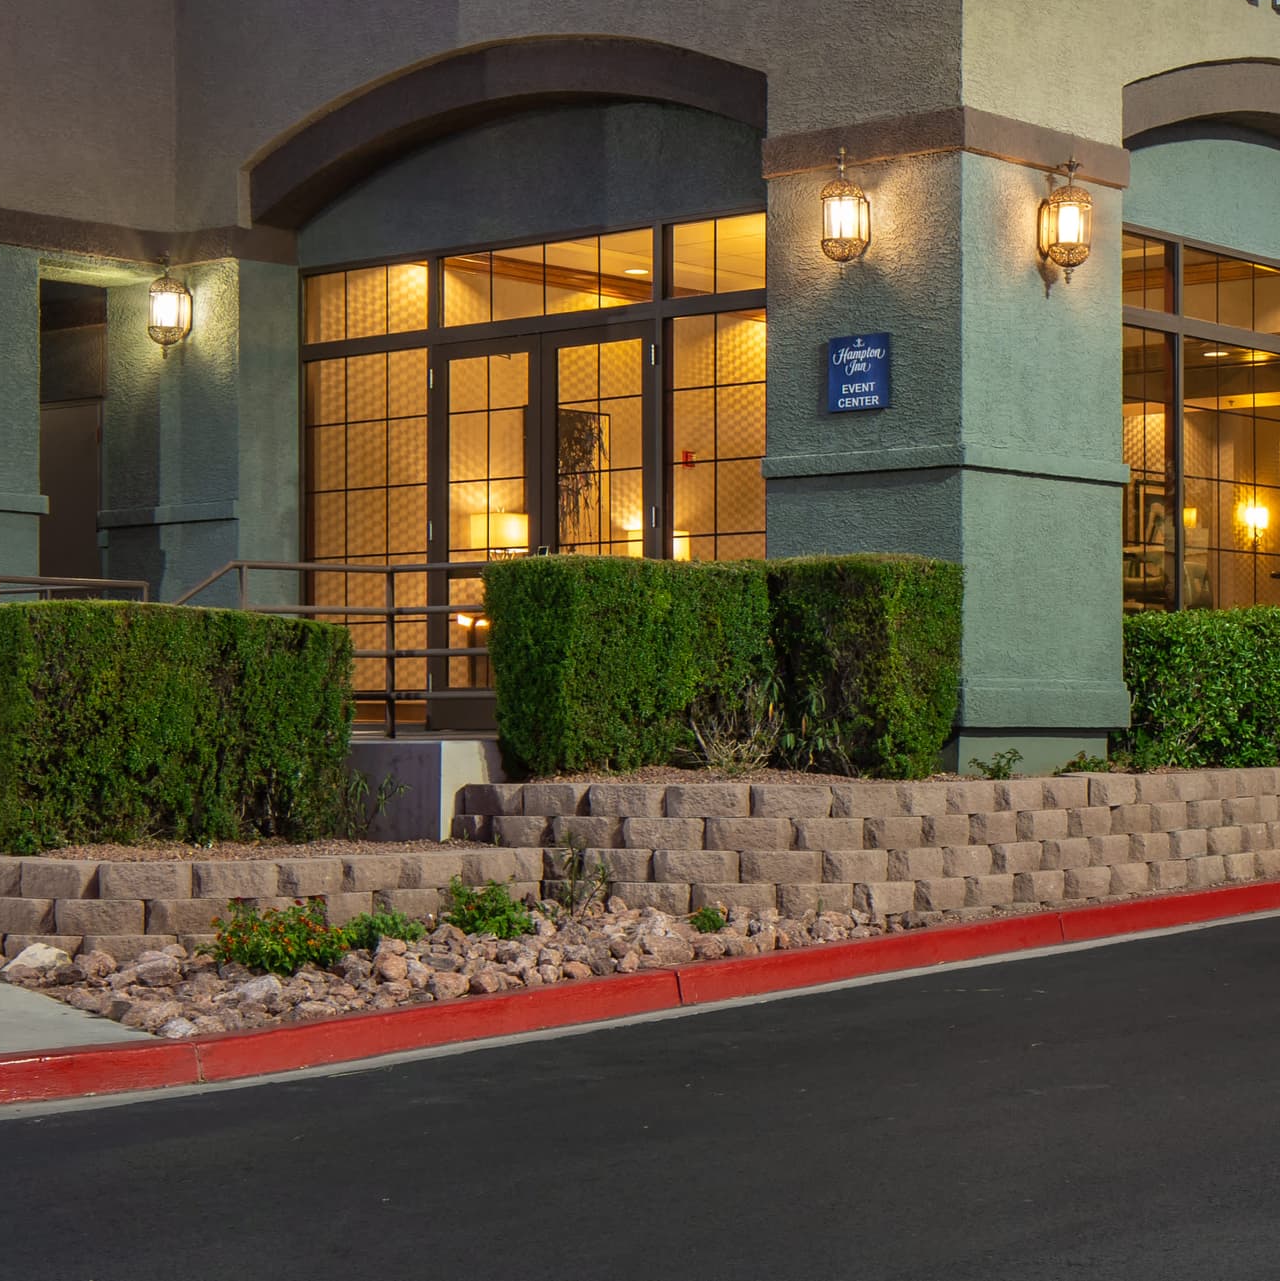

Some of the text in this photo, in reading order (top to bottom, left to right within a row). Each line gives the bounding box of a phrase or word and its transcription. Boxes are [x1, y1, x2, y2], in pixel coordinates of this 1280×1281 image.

[832, 347, 886, 365] Hampton
[845, 360, 871, 376] Inn
[841, 382, 876, 394] EVENT
[838, 395, 880, 408] CENTER
